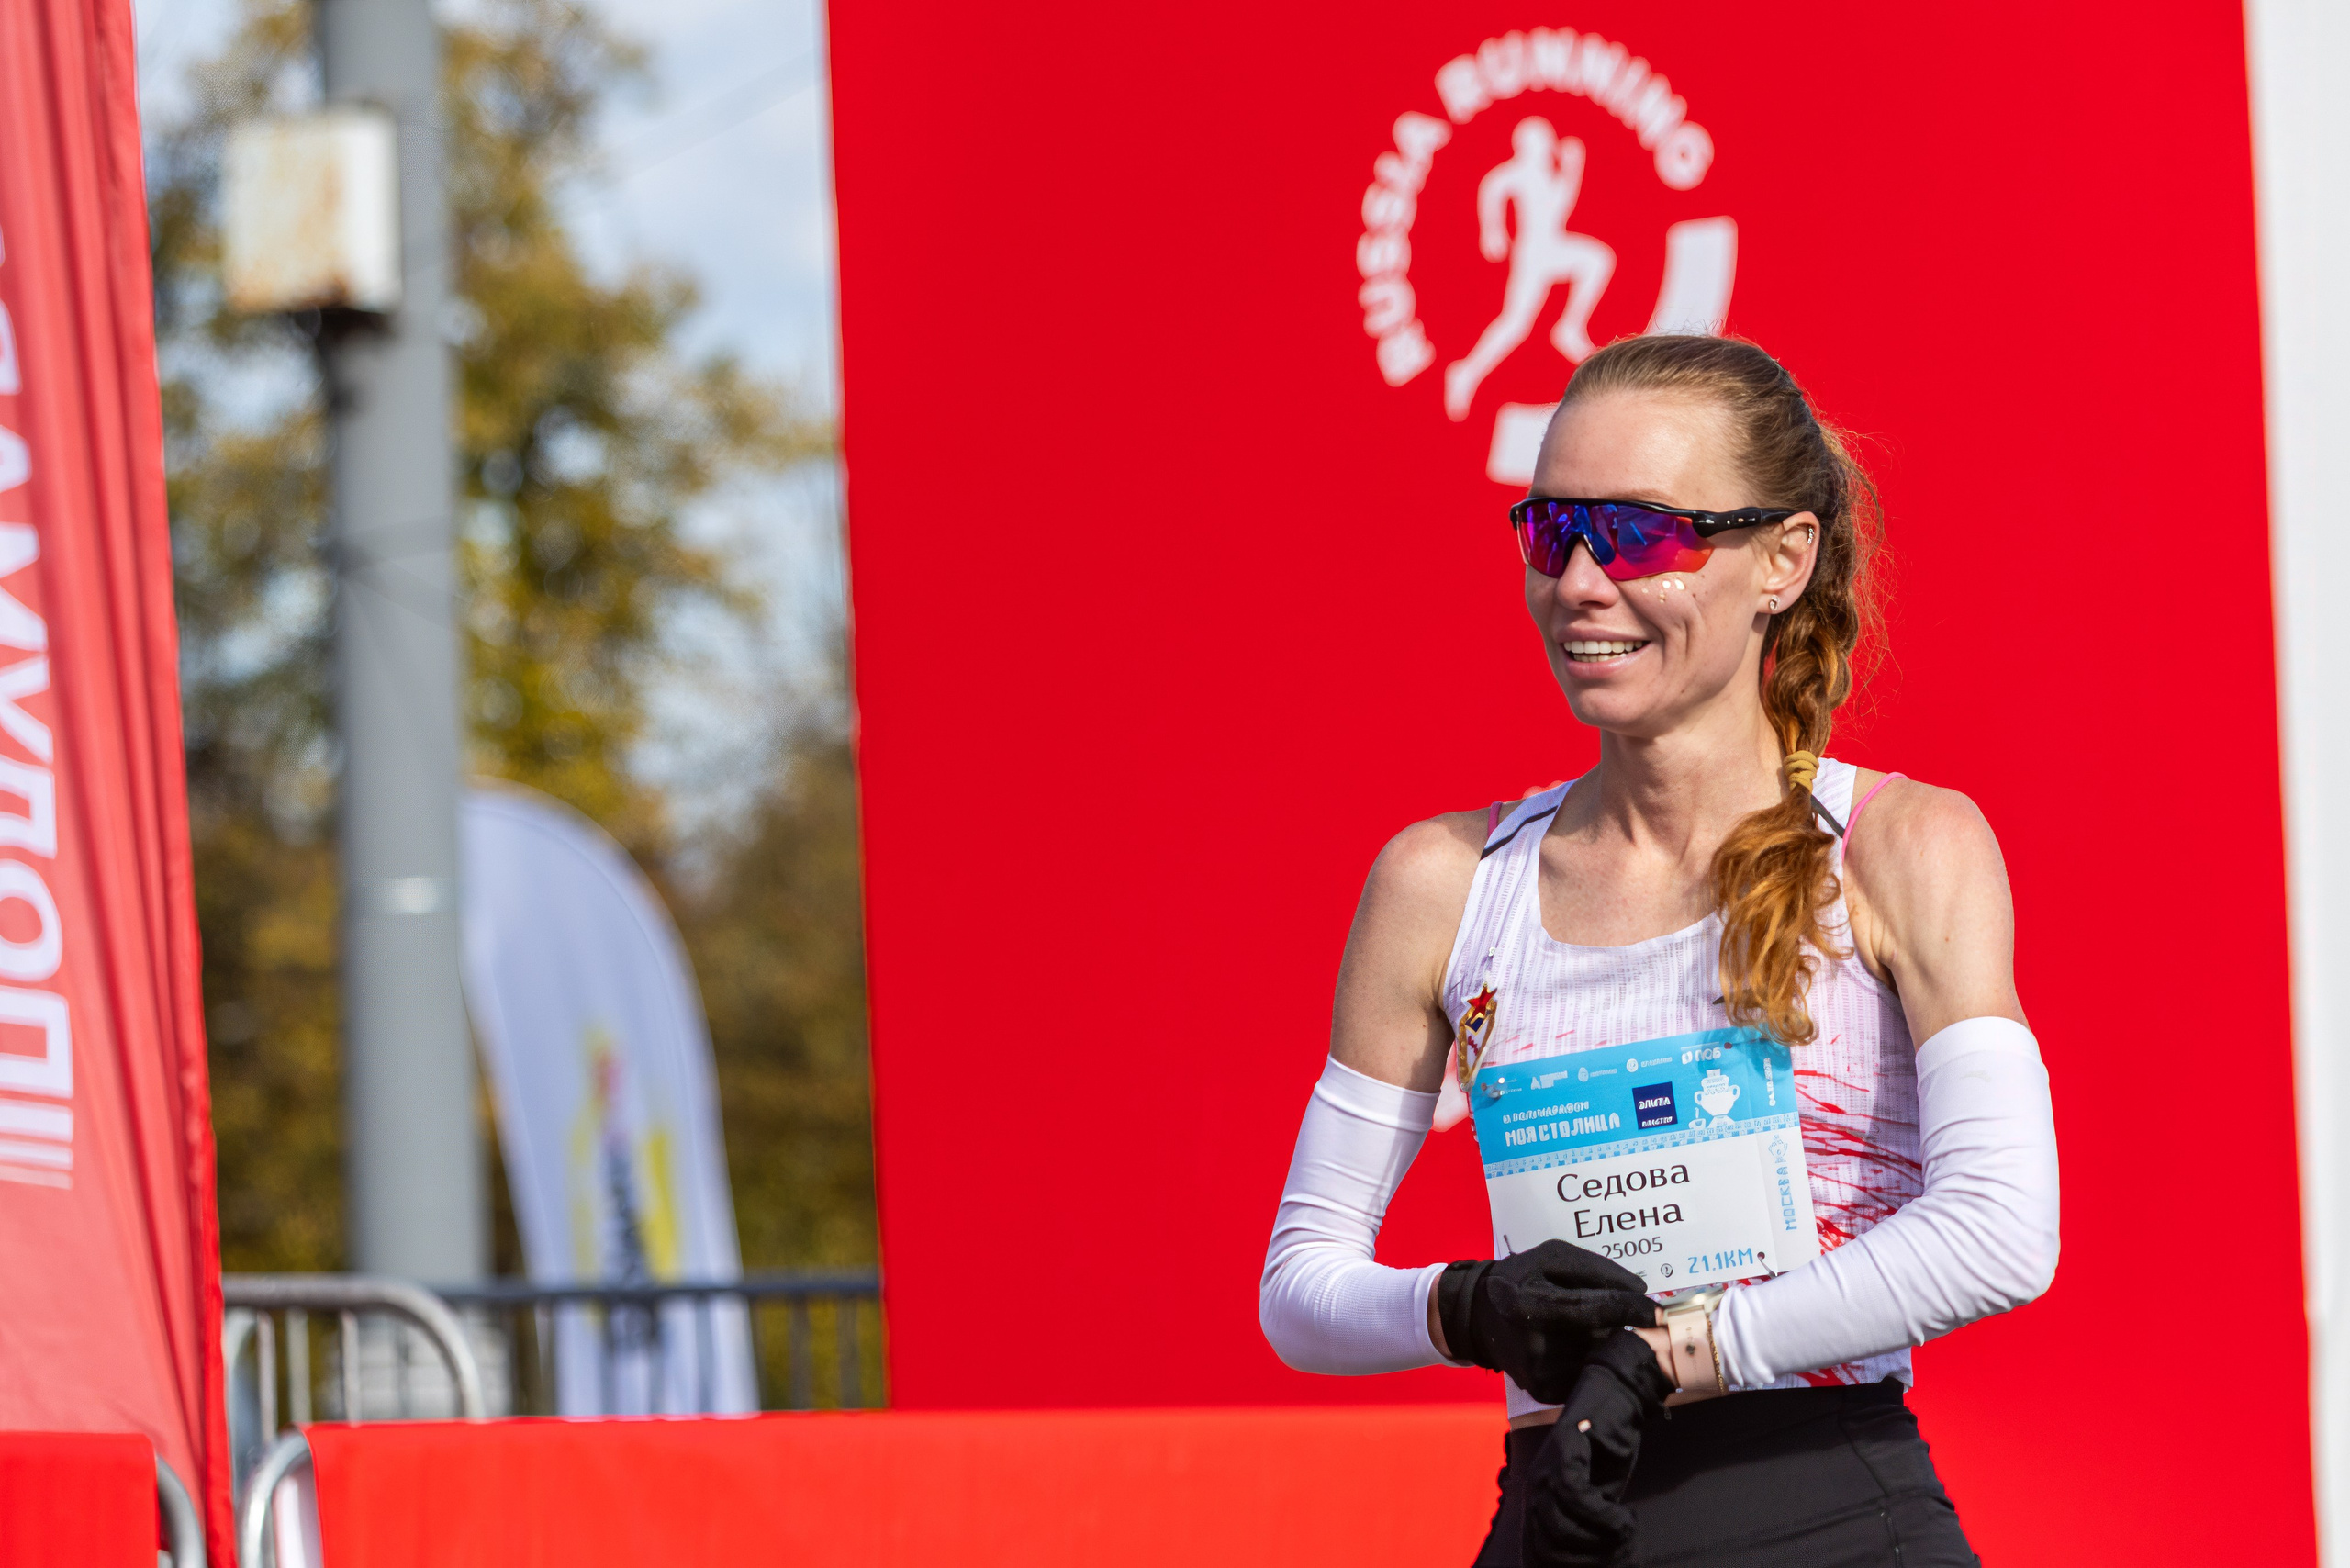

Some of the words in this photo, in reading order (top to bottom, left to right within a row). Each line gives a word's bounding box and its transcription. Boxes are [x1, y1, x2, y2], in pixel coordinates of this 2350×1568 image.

[1435, 26, 1715, 191] RUNNING
[1505, 1126, 1538, 1147] МОЯ
[1539, 1112, 1621, 1142] СТОЛИЦА
[1557, 1164, 1690, 1203] Седова
[1776, 1166, 1798, 1231] МОСКВА
[1573, 1204, 1684, 1238] Елена
[1601, 1236, 1663, 1260] 25005
